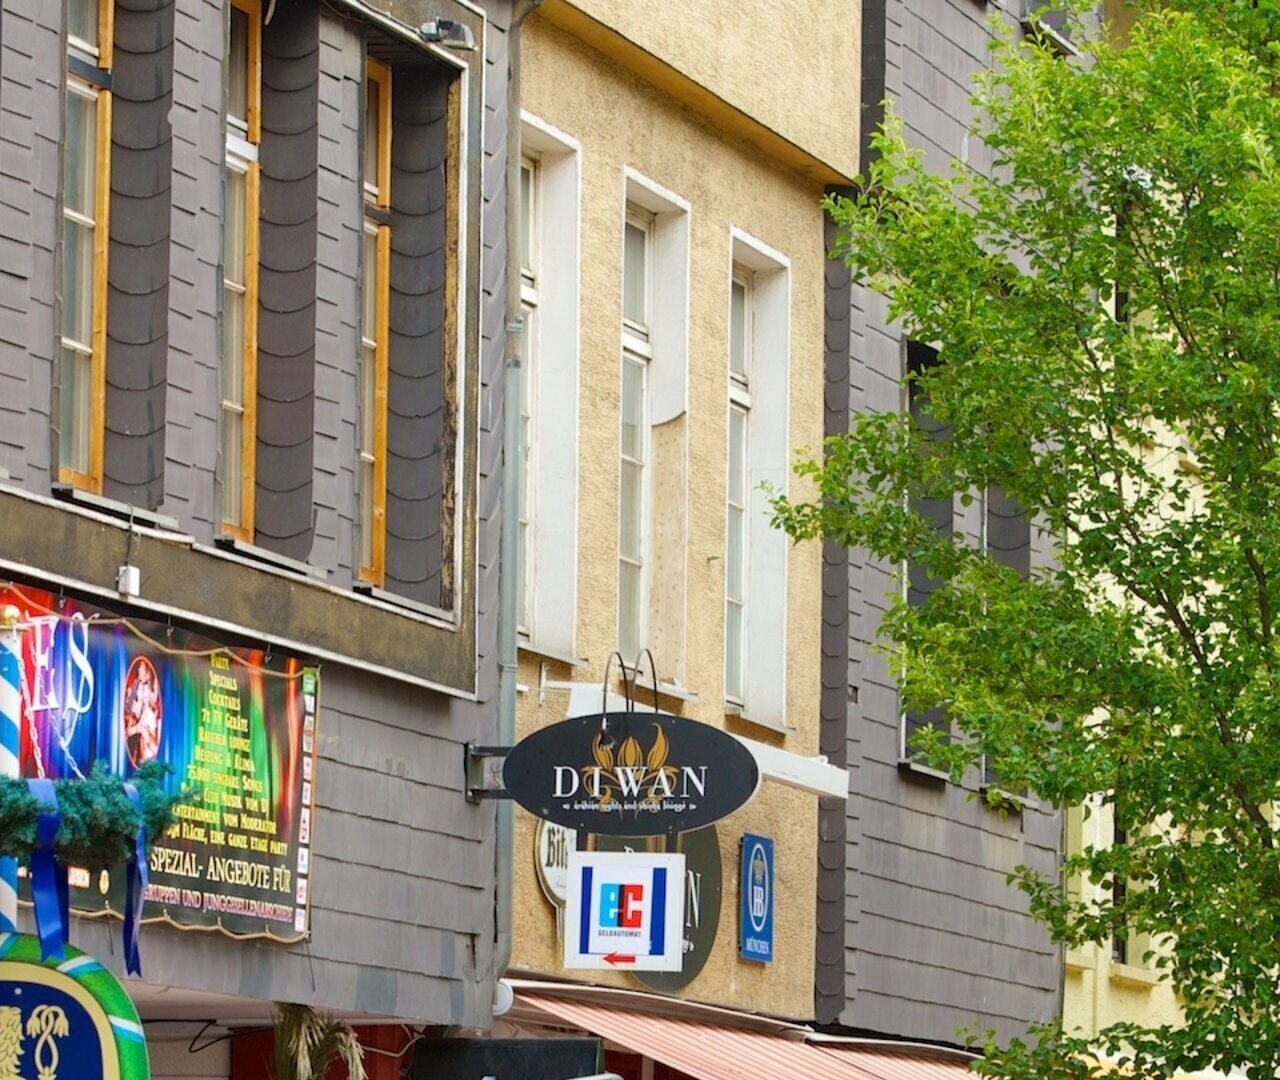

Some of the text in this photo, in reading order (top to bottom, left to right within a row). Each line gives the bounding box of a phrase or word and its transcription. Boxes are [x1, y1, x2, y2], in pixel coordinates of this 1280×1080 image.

[552, 765, 709, 799] DIWAN
[150, 846, 292, 894] SPEZIAL- ANGEBOTE FÜR
[144, 884, 182, 904] GRUPPEN
[182, 889, 202, 908] UND
[597, 929, 642, 938] GELDAUTOMAT
[745, 936, 770, 955] MÜNCHEN
